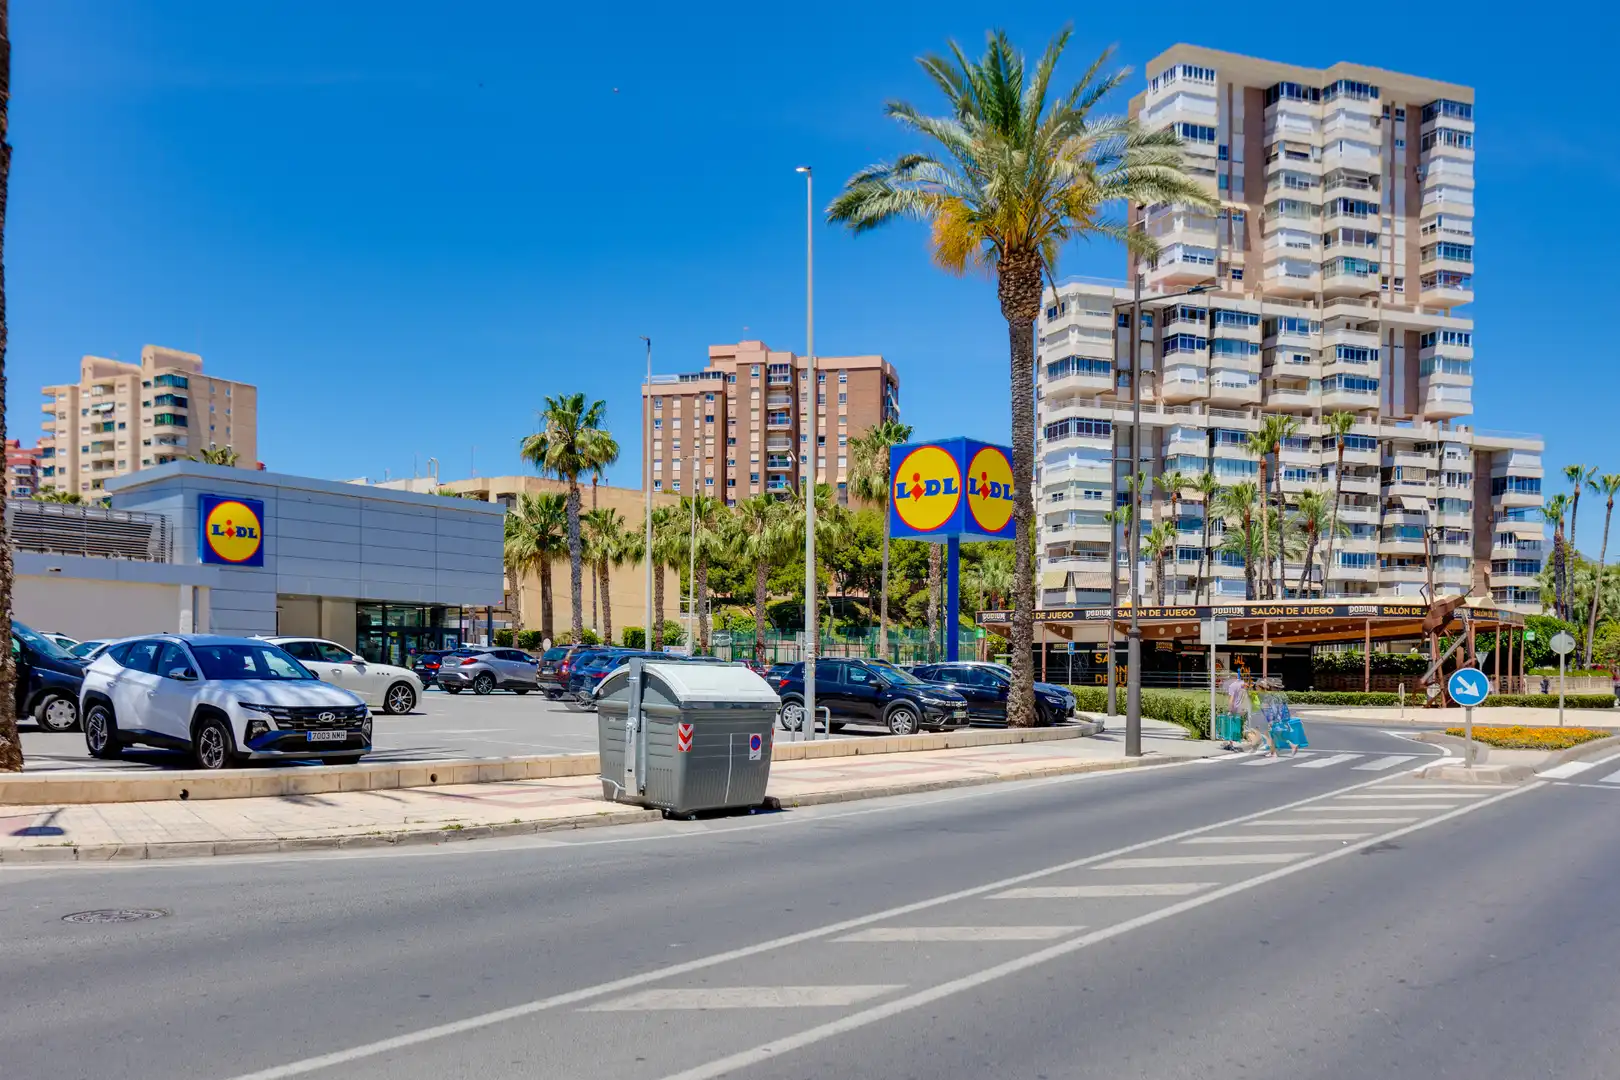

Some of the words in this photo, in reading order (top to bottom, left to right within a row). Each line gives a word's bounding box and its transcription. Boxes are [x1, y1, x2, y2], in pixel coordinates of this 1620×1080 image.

[1149, 609, 1161, 617] DE
[1163, 608, 1196, 617] JUEGO
[1251, 605, 1284, 615] SALÓN
[1286, 607, 1298, 615] DE
[1301, 606, 1334, 615] JUEGO
[1348, 605, 1378, 616] PODIUM
[1383, 606, 1410, 615] SALÓN
[1411, 607, 1422, 615] DE
[1047, 611, 1074, 619] JUEGO
[312, 732, 331, 740] 7003
